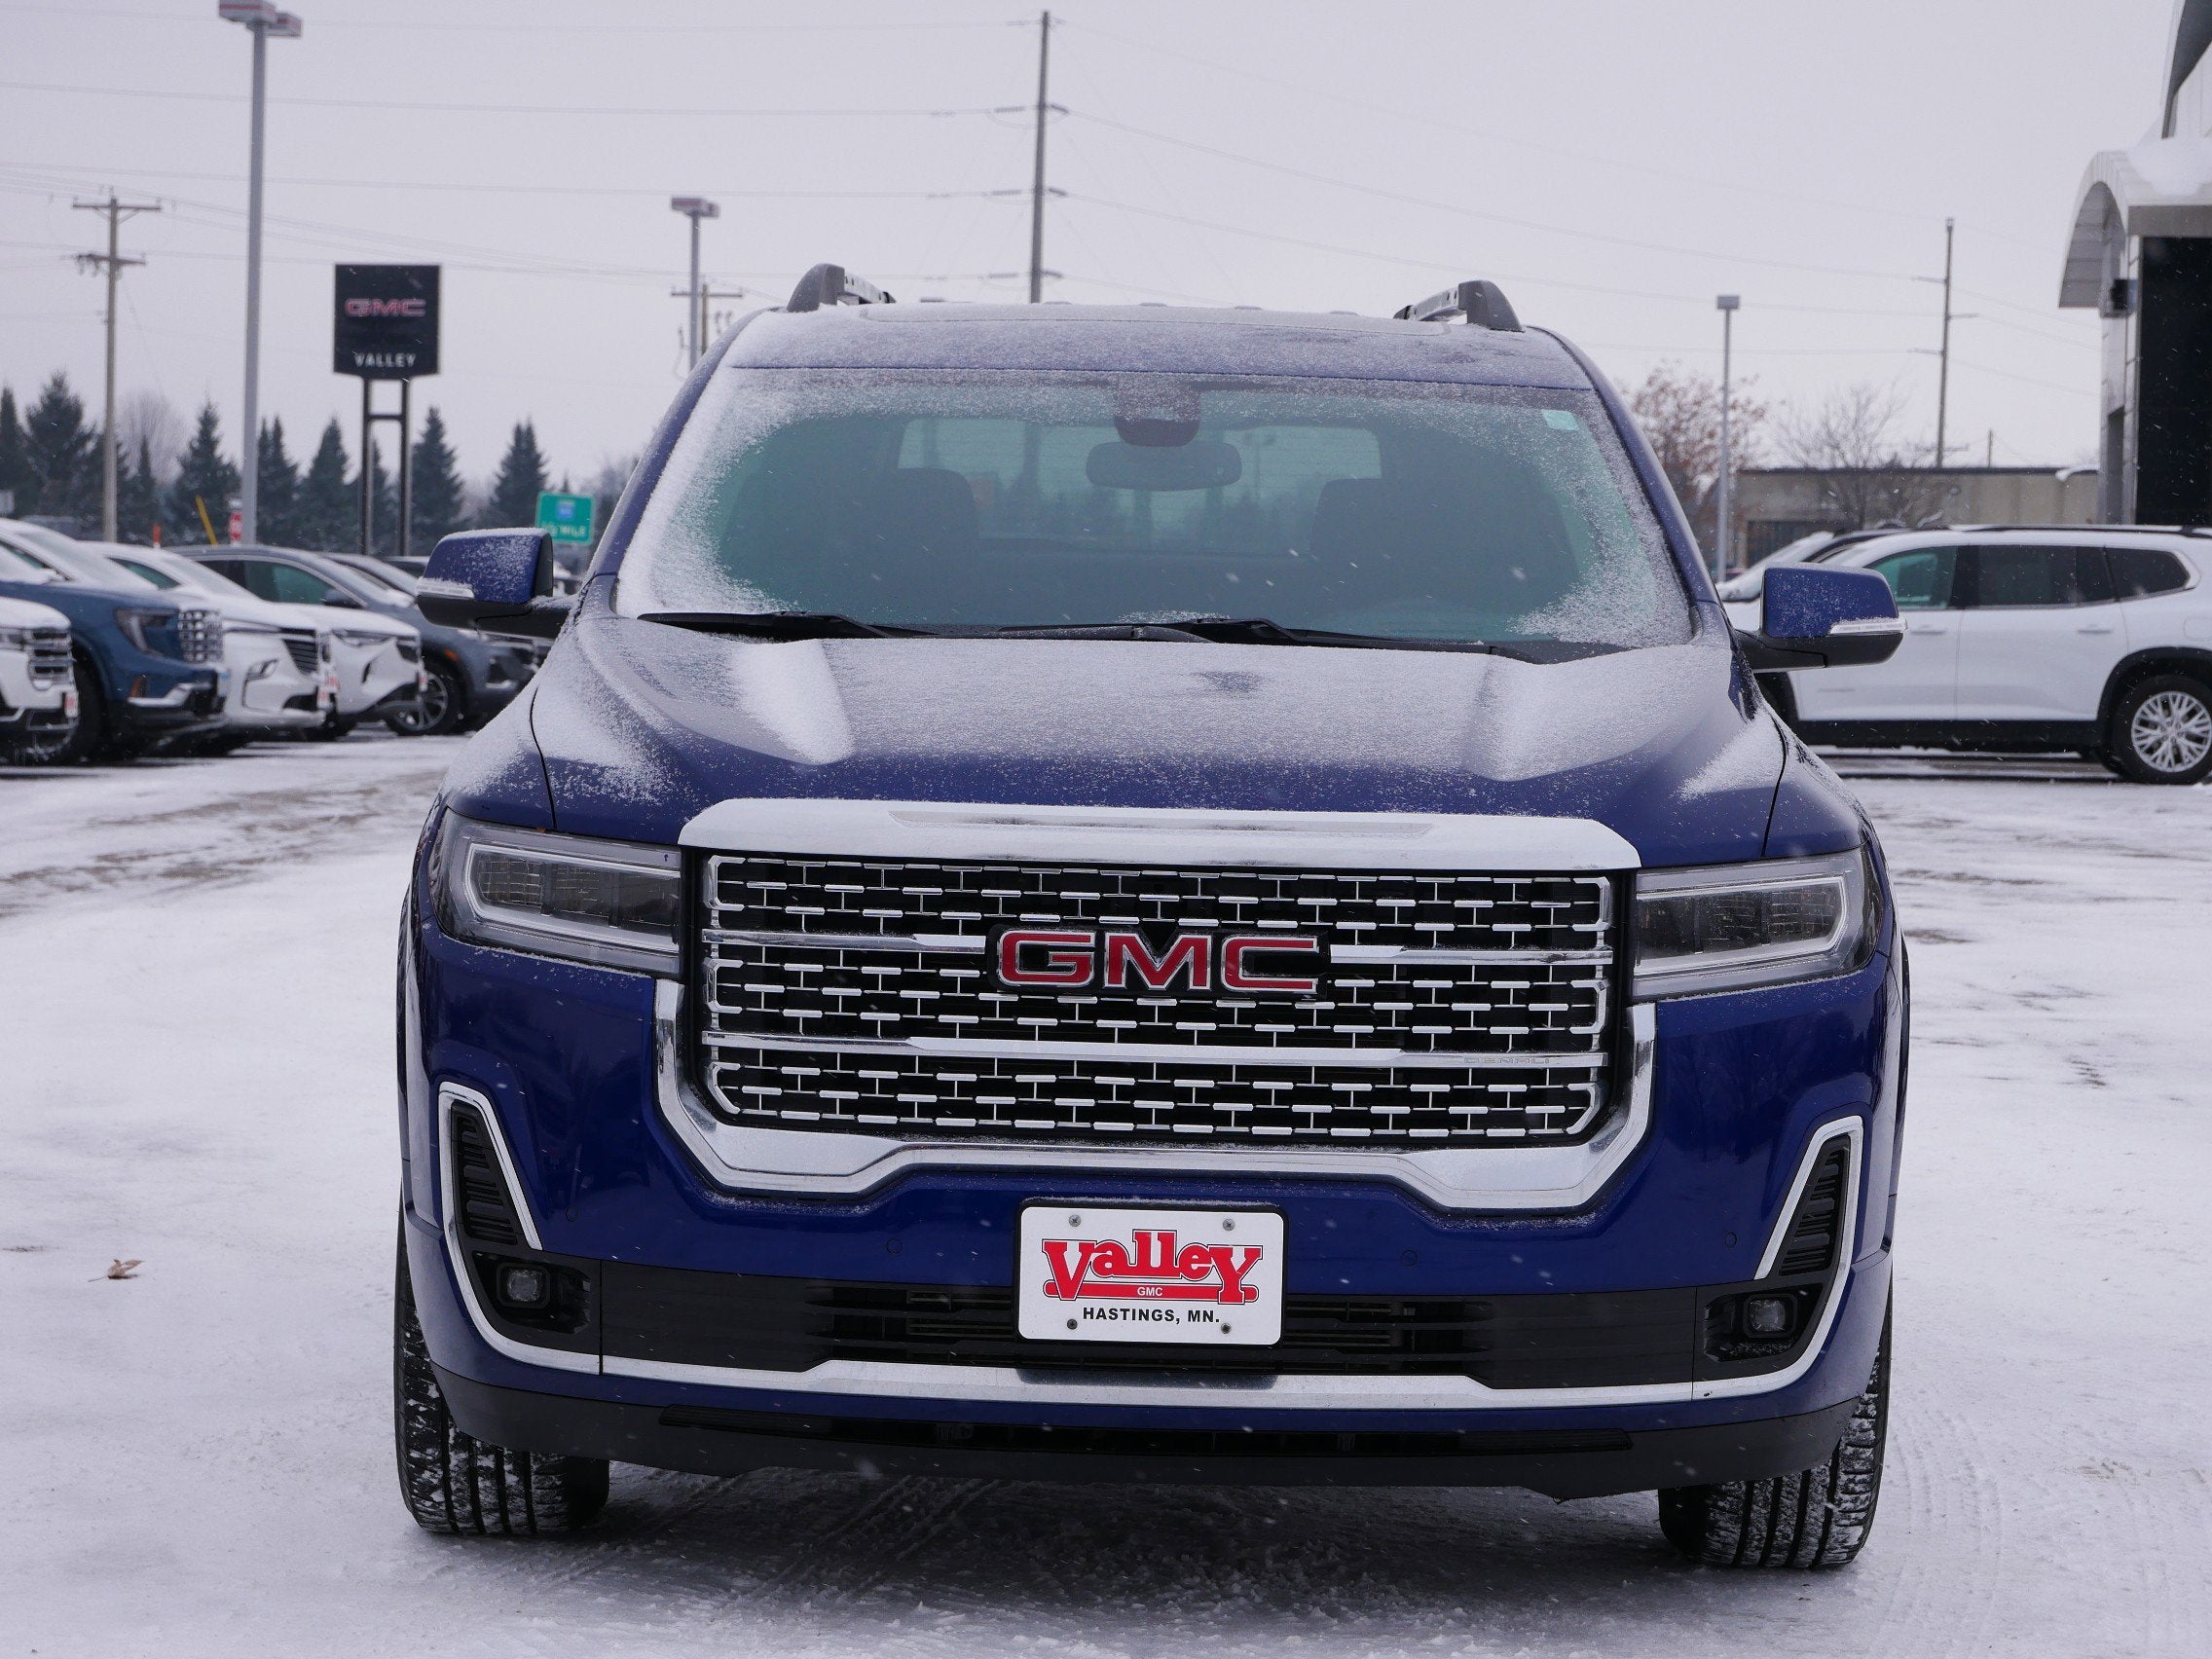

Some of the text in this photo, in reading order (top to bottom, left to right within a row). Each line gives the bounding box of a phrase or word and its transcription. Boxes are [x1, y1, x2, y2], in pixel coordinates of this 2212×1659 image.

[345, 298, 426, 317] GMC
[354, 352, 417, 368] VALLEY
[998, 930, 1319, 994] GMC
[1136, 1286, 1163, 1297] GMC
[1083, 1307, 1220, 1325] HASTINGS, MN.
